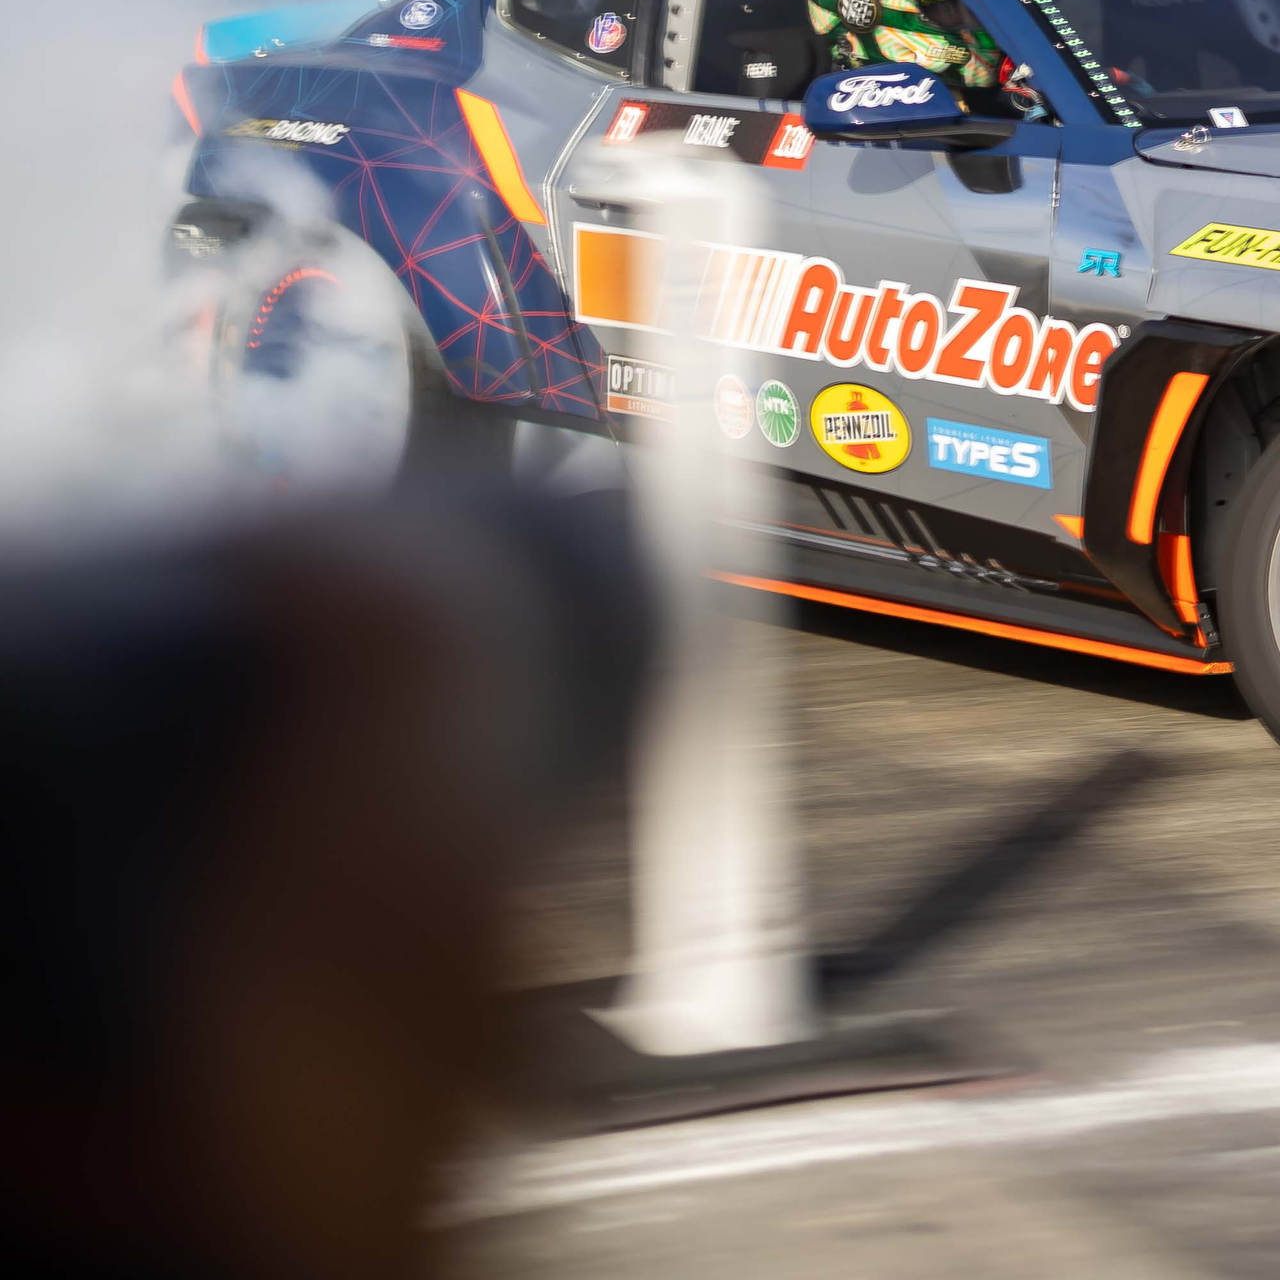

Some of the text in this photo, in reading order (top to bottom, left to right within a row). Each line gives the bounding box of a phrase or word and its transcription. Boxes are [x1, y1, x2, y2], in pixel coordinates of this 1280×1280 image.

[827, 73, 938, 113] Ford
[266, 120, 350, 145] RACING
[684, 114, 741, 148] DEANE
[1076, 246, 1122, 278] RTR
[778, 263, 1118, 407] AutoZone
[763, 397, 790, 416] NTK
[823, 413, 897, 440] PENNZOIL
